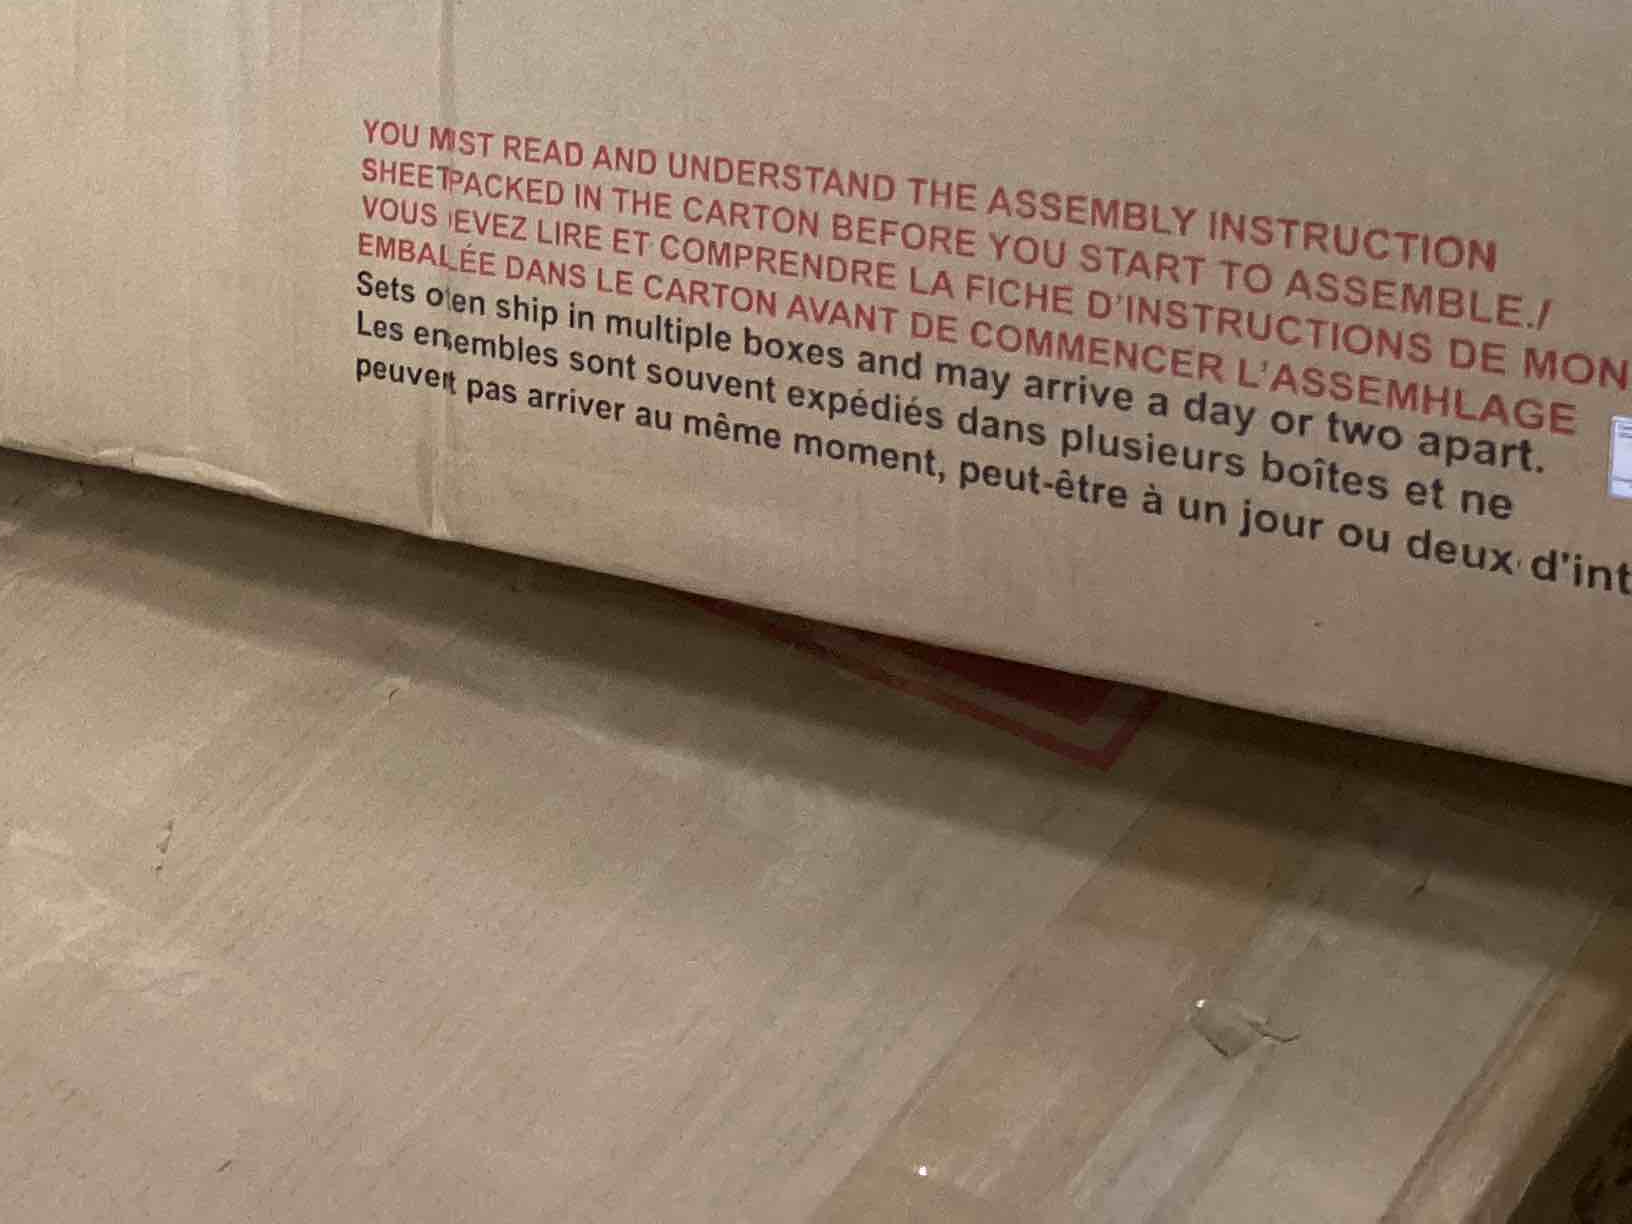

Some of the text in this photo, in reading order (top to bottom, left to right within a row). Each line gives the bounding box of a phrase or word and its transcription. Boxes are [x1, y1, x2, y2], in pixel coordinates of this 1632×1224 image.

[362, 195, 438, 228] VOUS
[448, 208, 527, 241] EVEZ
[537, 219, 603, 251] LIRE
[612, 227, 651, 257] ET
[660, 234, 896, 290] COMPRENDRE
[910, 266, 955, 299] LA
[966, 273, 1073, 315] FICHE
[1450, 338, 1506, 375] DE
[363, 119, 420, 148] YOU
[503, 134, 584, 168] READ
[592, 144, 657, 176] AND
[668, 151, 895, 202] UNDERSTAND
[907, 177, 977, 212] THE
[987, 186, 1196, 236] ASSEMBLY
[1209, 211, 1496, 272] INSTRUCTION
[574, 183, 603, 211] IN
[610, 187, 672, 220] THE
[683, 196, 819, 238] CARTON
[832, 213, 976, 257] BEFORE
[989, 233, 1066, 269] YOU
[1080, 243, 1206, 285] START
[1220, 260, 1272, 294] TO
[356, 270, 415, 304] Sets
[496, 294, 559, 332] ship
[569, 301, 594, 332] in
[605, 314, 731, 353] multiple
[743, 326, 844, 369] boxes
[858, 350, 922, 381] and
[936, 362, 1010, 398] may
[1024, 374, 1133, 411] arrive
[1148, 392, 1168, 417] a
[1184, 391, 1255, 434] day
[1271, 410, 1313, 437] or
[1328, 411, 1403, 450] two
[1418, 431, 1543, 473] apart.
[505, 255, 587, 289] DANS
[597, 267, 633, 296] LE
[643, 274, 777, 318] CARTON
[786, 294, 899, 334] AVANT
[911, 311, 957, 344] DE
[970, 320, 1223, 383] COMMENCER
[357, 309, 404, 342] Les
[569, 350, 636, 381] sont
[646, 363, 776, 404] souvent
[787, 385, 944, 430] expédiés
[958, 406, 1046, 446] dans
[1062, 423, 1245, 477] plusieurs
[1262, 450, 1388, 500] boîtes
[1406, 478, 1444, 510] et
[1461, 490, 1512, 520] ne
[466, 378, 518, 405] pas
[527, 388, 626, 422] arriver
[635, 406, 672, 431] au
[683, 412, 781, 450] même
[794, 433, 945, 484] moment,
[959, 460, 1127, 508] peut-être
[1142, 483, 1162, 515] à
[1178, 497, 1226, 525] un
[1239, 499, 1324, 540] jour
[1338, 523, 1389, 553] ou
[1407, 529, 1512, 575] deux
